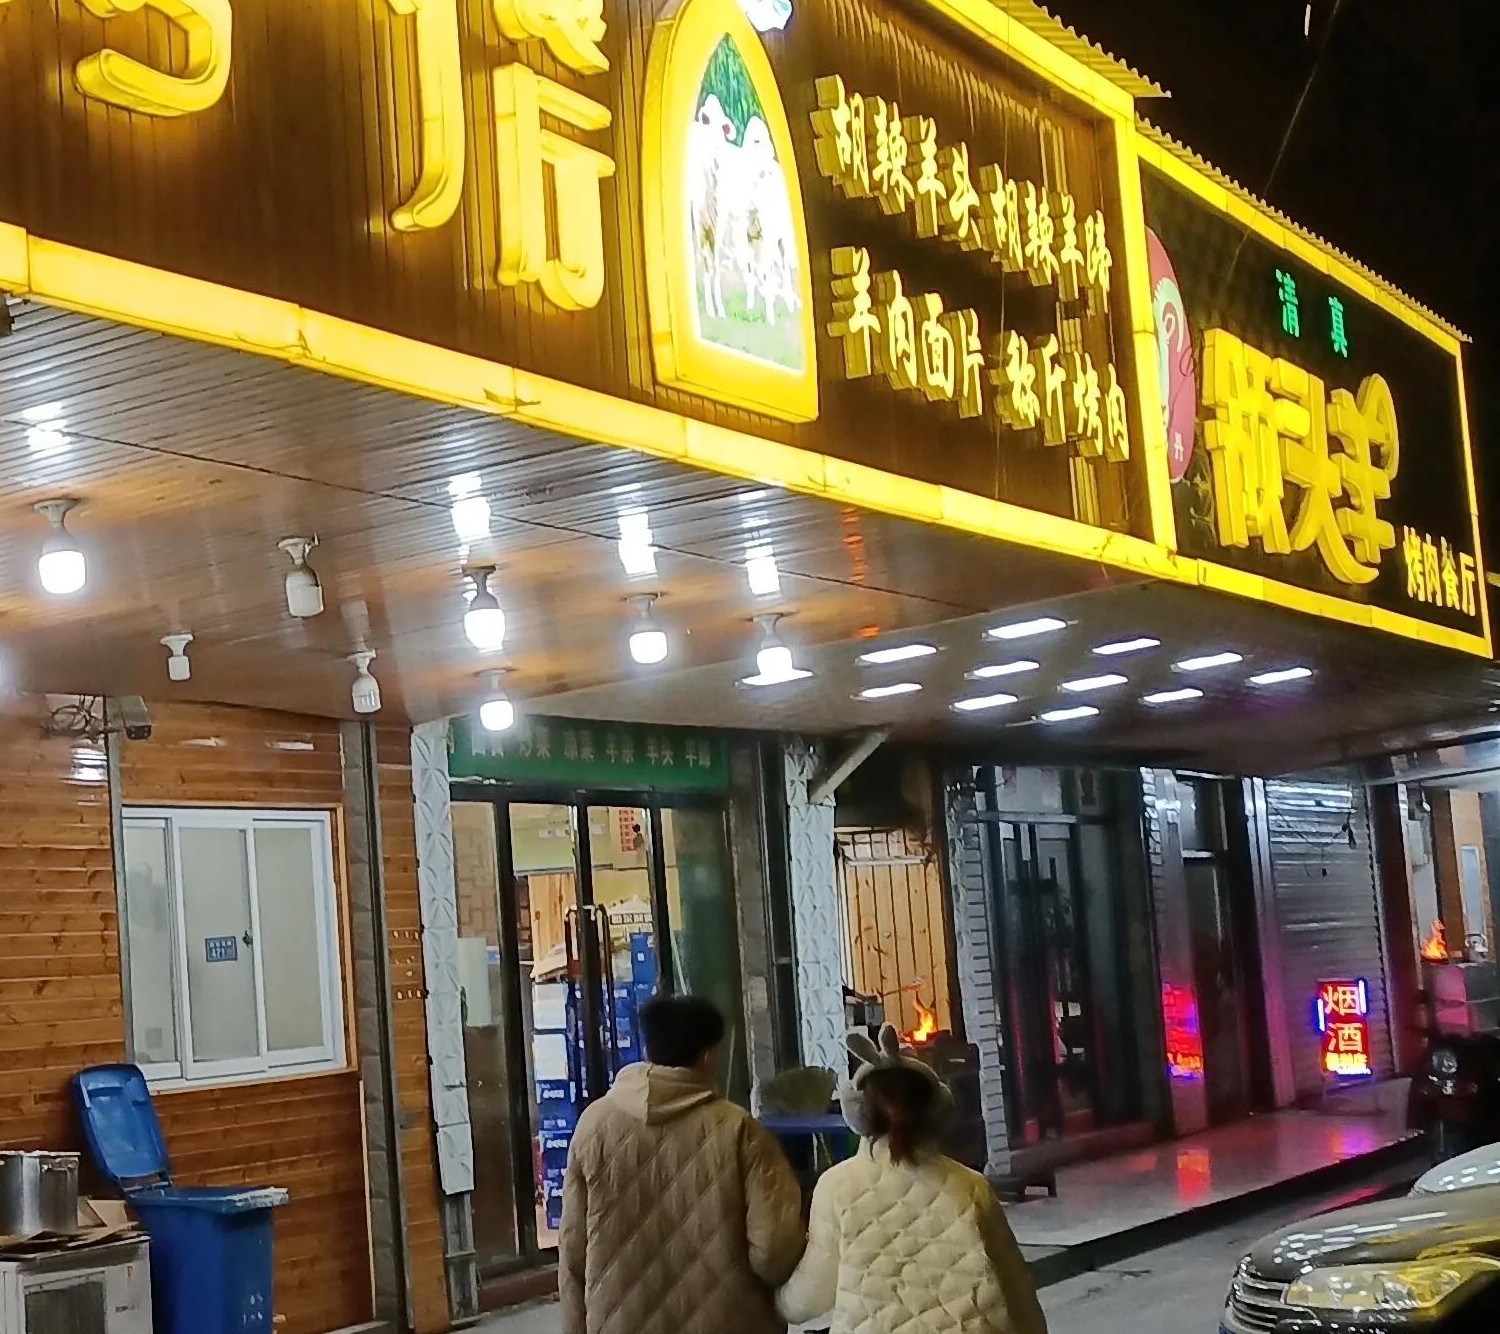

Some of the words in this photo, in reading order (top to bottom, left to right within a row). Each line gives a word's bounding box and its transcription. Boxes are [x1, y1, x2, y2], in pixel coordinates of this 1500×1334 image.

[830, 245, 986, 418] 羊肉面片
[1275, 268, 1348, 358] 清真
[1403, 525, 1477, 617] 烤肉餐厅
[1323, 985, 1366, 1054] 烟酒
